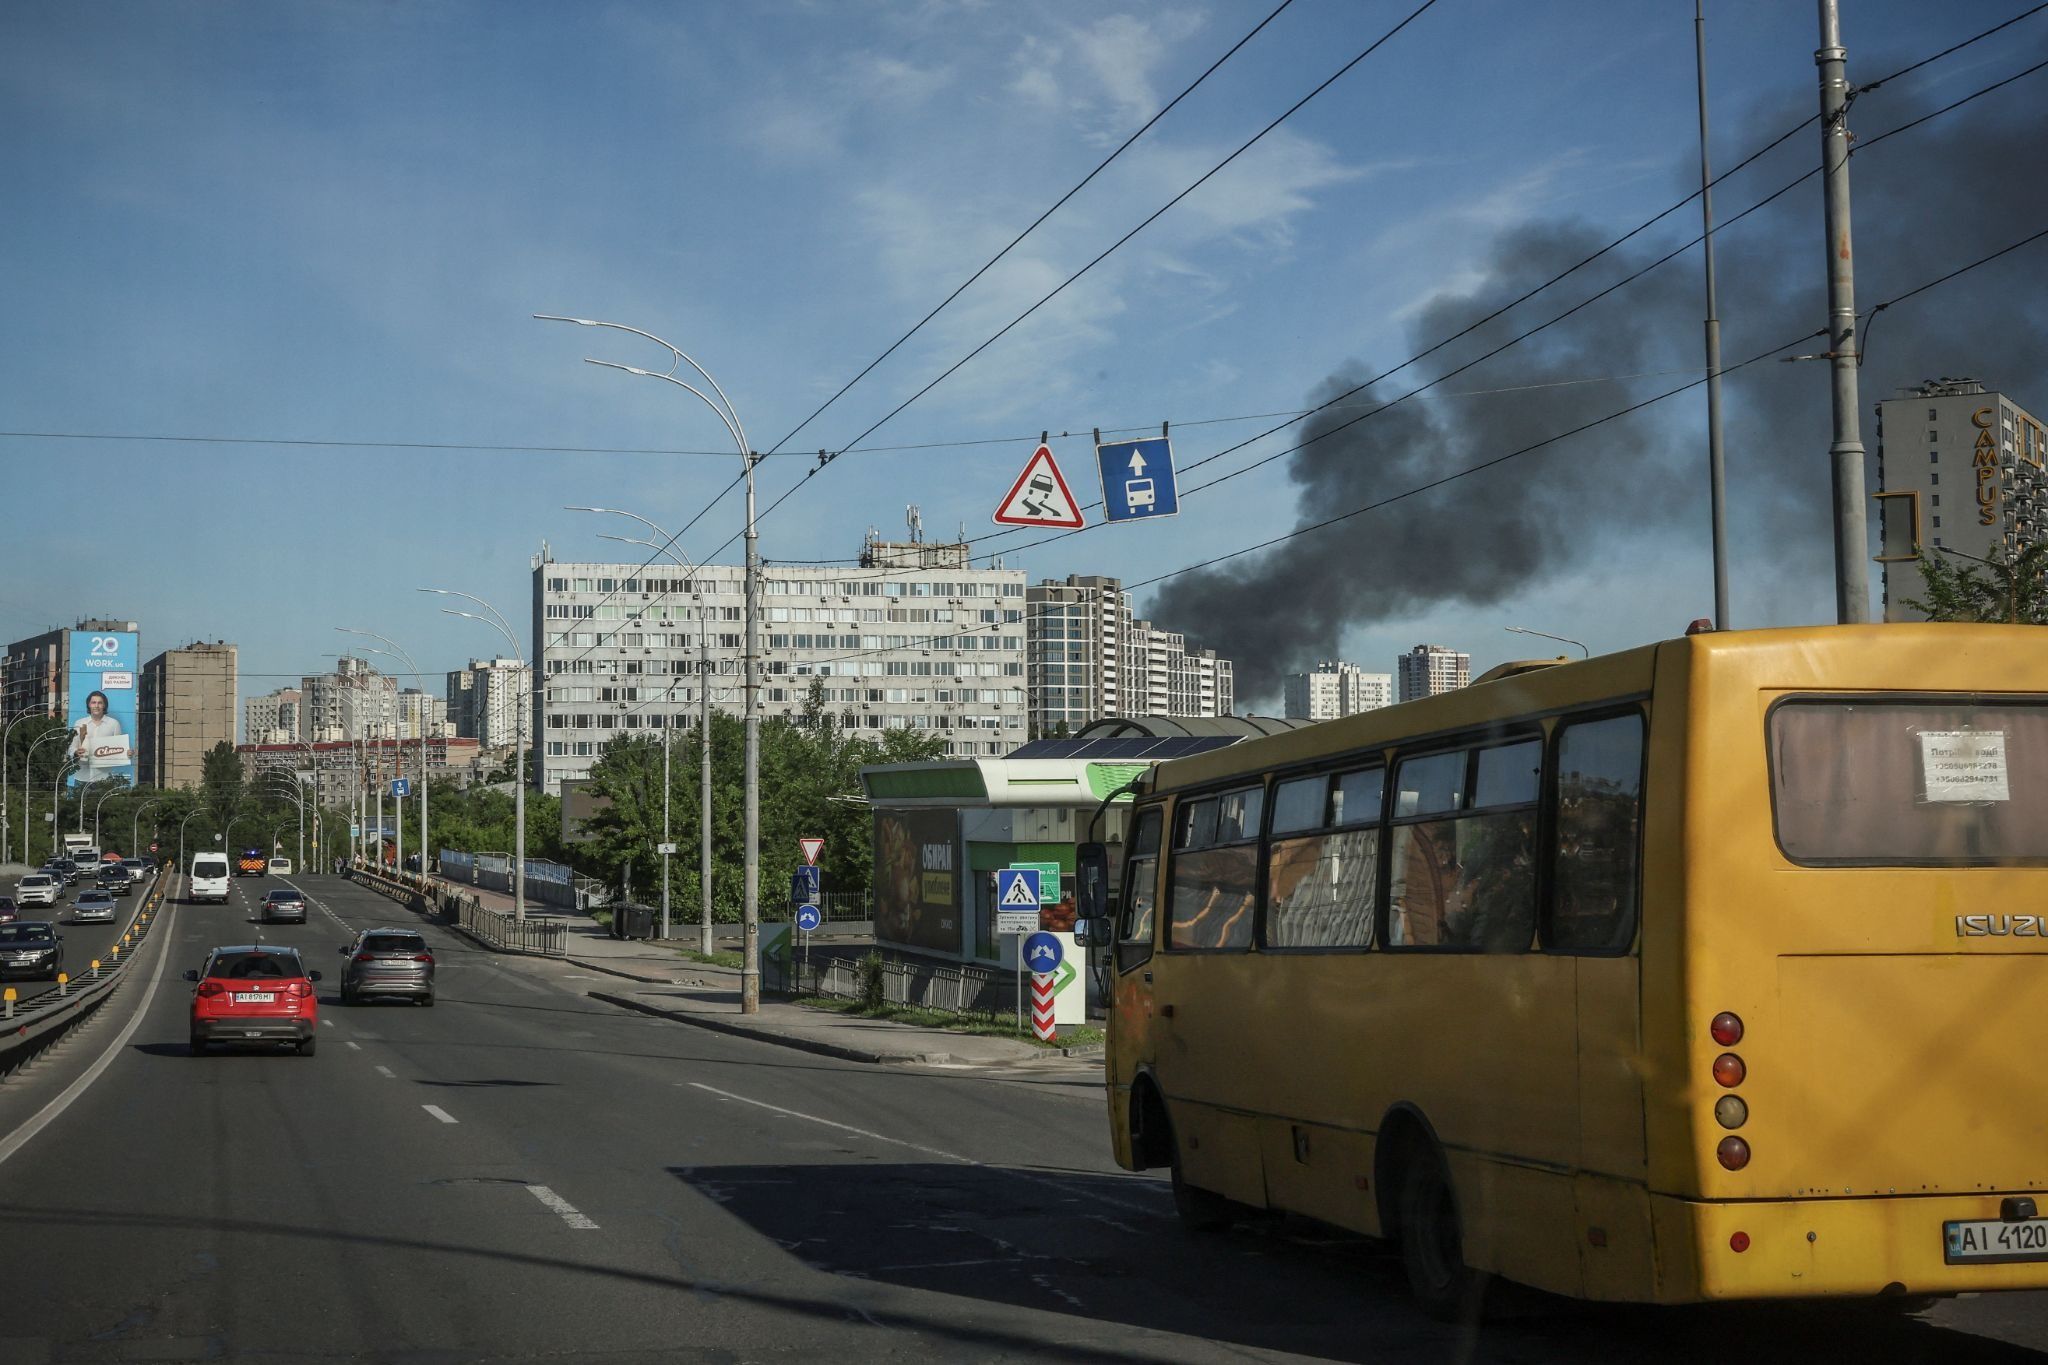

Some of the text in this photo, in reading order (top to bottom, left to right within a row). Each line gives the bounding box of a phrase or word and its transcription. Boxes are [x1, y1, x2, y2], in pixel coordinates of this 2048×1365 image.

[1971, 408, 1999, 527] CAMPUS
[92, 636, 119, 653] 20
[85, 659, 124, 668] WORK.ua
[922, 840, 952, 870] ОБИРАЙ
[1962, 1225, 2047, 1251] AI 4120
